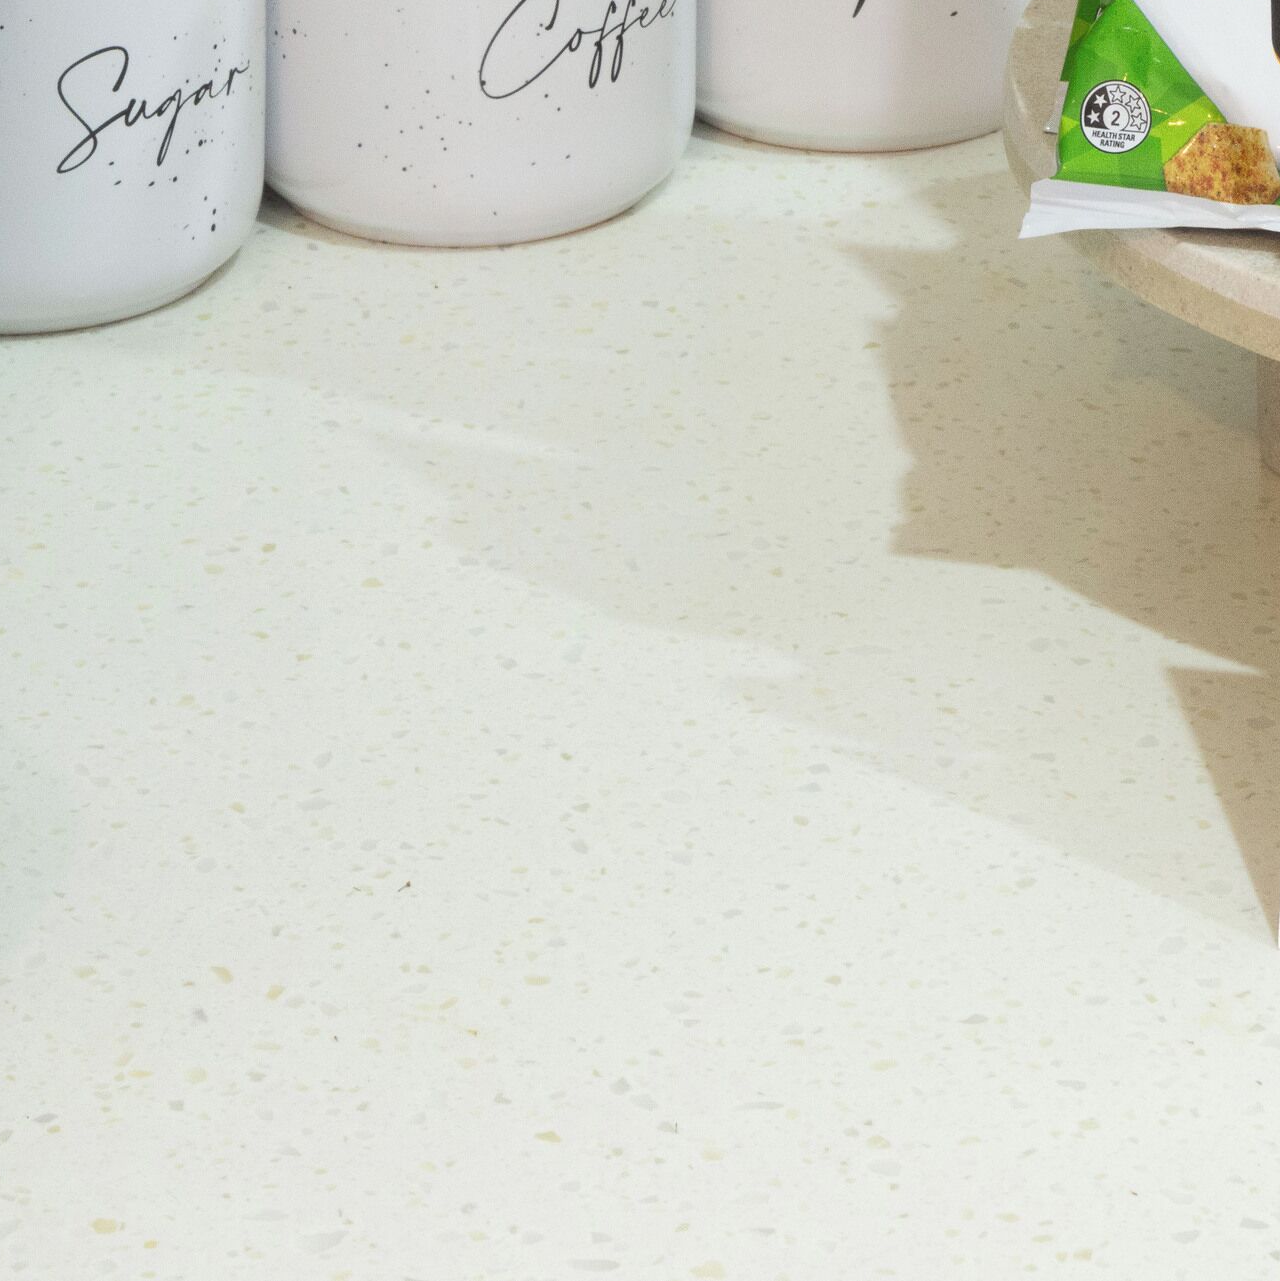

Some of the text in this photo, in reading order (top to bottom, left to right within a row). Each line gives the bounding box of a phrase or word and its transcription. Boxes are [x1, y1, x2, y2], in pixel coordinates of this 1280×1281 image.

[56, 45, 250, 175] Sugar
[1110, 110, 1120, 126] 2
[1091, 130, 1135, 141] HEALTH STAR
[1099, 139, 1125, 148] RATING
